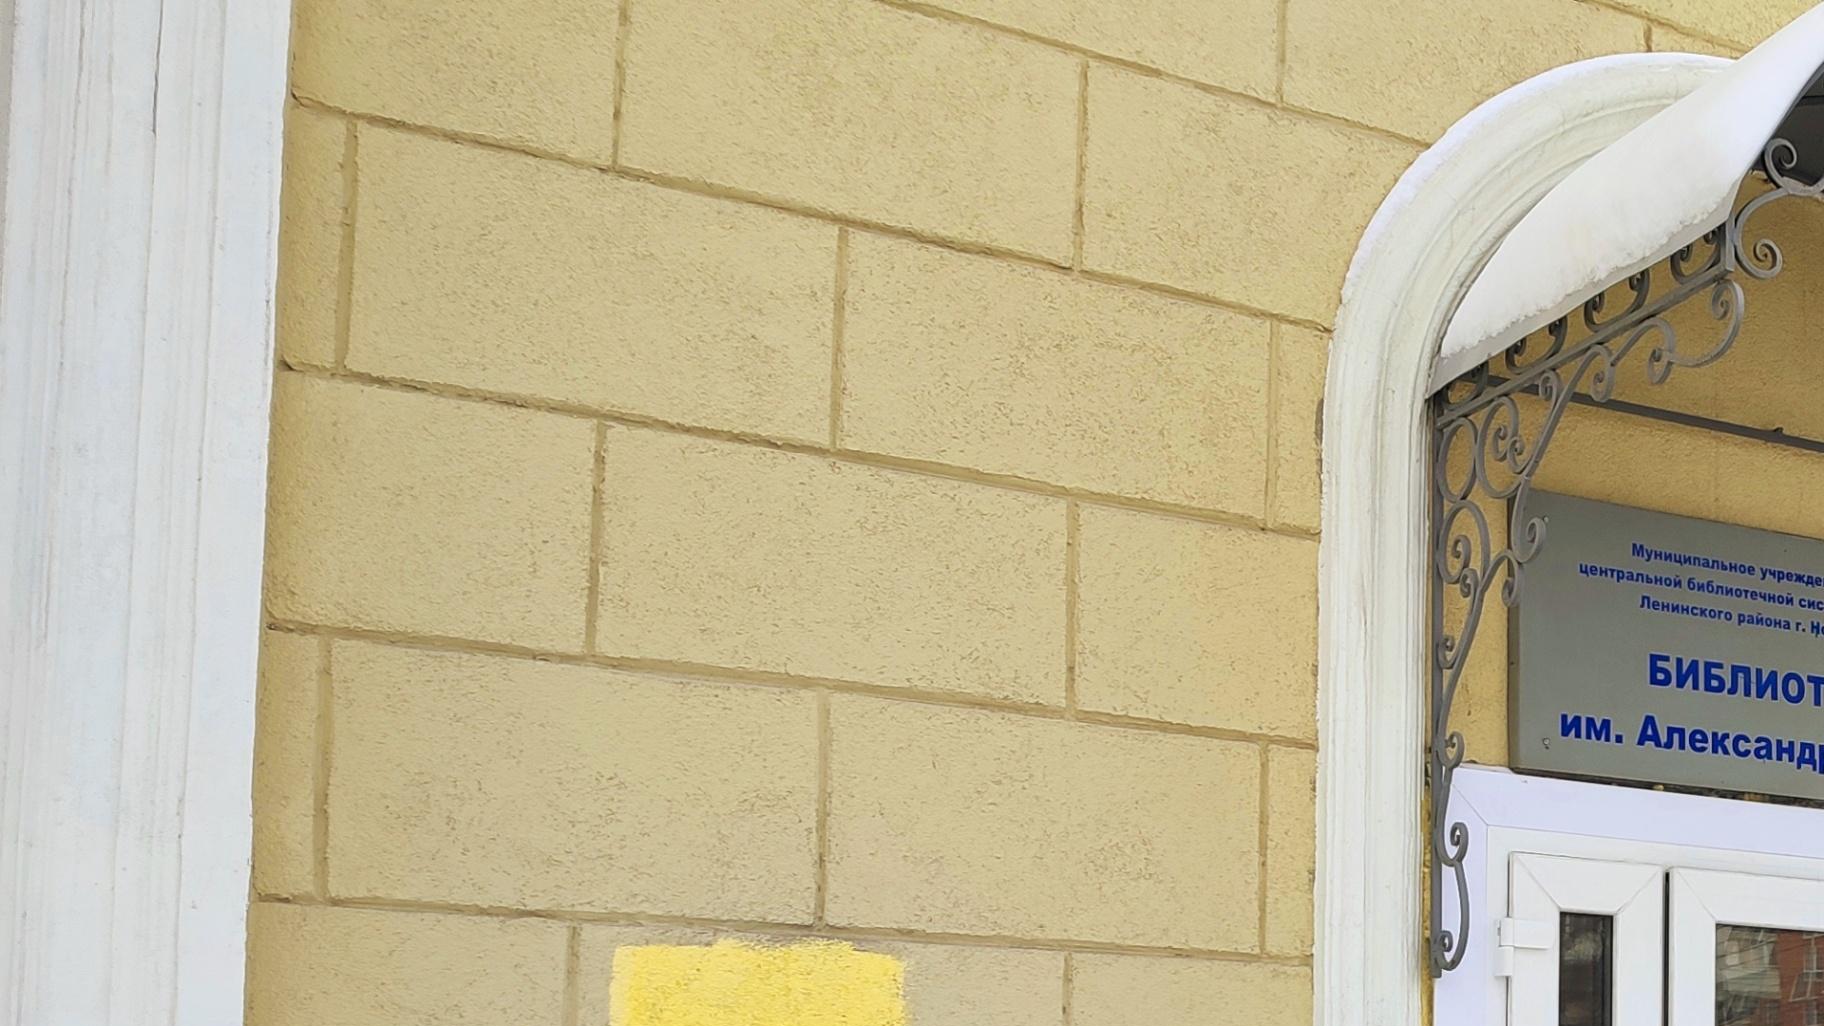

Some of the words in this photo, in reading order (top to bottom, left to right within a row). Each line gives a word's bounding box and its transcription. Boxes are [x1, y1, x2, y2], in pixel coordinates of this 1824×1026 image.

[1631, 543, 1756, 576] Муниципальное
[1578, 562, 1682, 590] центральной
[1687, 574, 1794, 607] библиотечной
[1640, 595, 1733, 623] Ленинского
[1737, 610, 1791, 631] района
[1795, 620, 1806, 633] г.
[1559, 713, 1624, 745] им.
